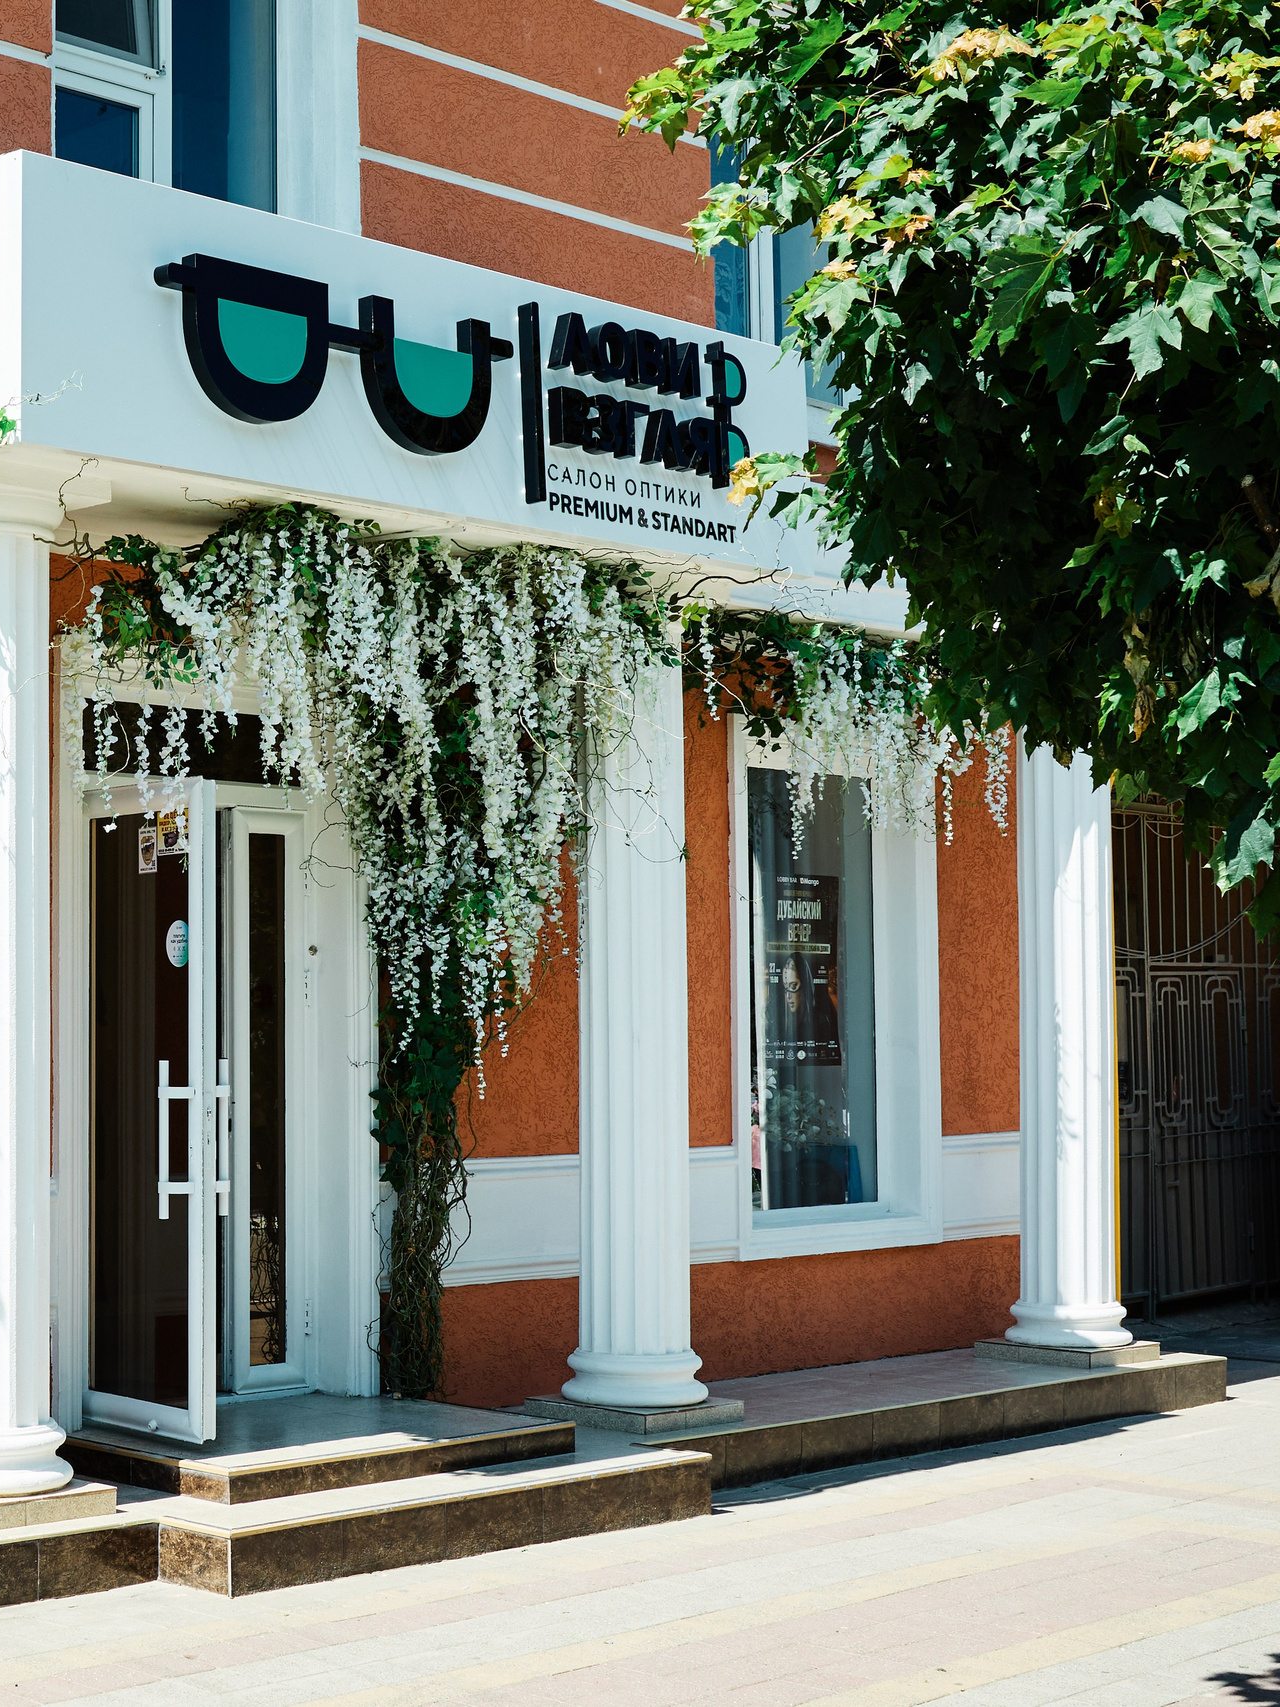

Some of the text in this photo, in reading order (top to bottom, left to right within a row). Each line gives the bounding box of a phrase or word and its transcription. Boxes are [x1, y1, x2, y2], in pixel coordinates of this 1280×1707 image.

[547, 312, 701, 400] ЛОВИ
[547, 463, 701, 508] САЛОН ОПТИКИ
[549, 491, 737, 543] PREMIUM & STANDART
[776, 898, 822, 921] ДУБАЙСКИЙ
[788, 923, 812, 942] ВЕЧЕР
